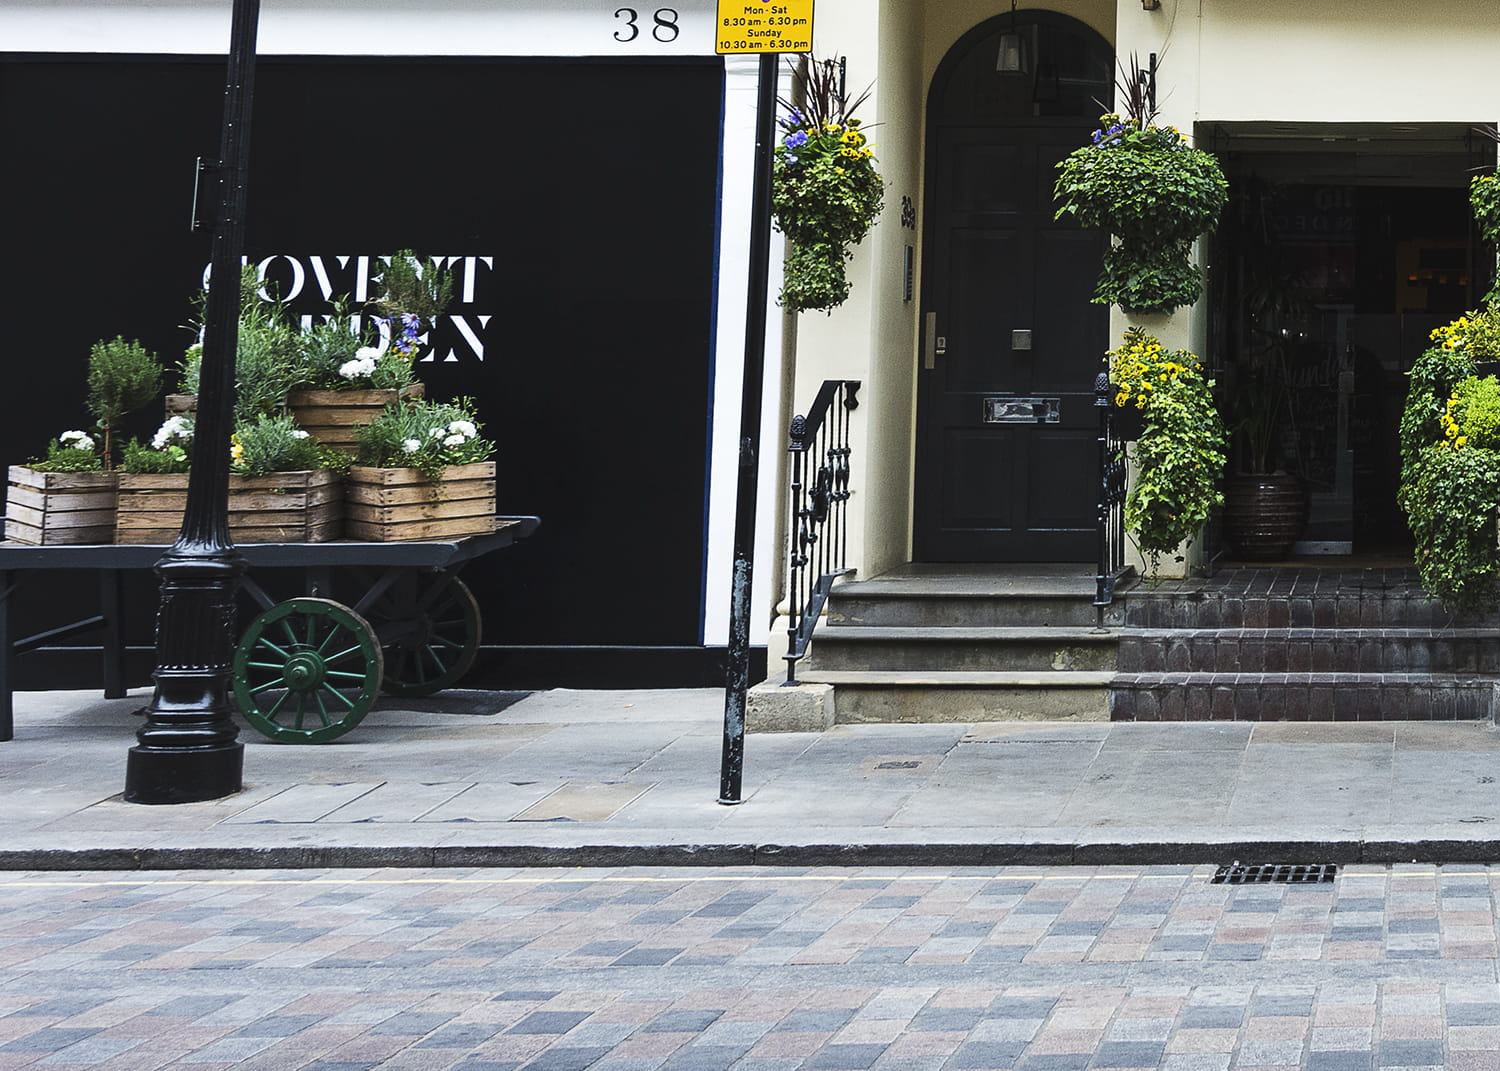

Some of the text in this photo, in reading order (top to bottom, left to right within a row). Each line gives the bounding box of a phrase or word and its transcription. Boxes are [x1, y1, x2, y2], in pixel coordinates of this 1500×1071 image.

[744, 7, 764, 15] Mon
[771, 5, 788, 15] Sat
[612, 7, 680, 43] 38
[723, 18, 746, 27] 8.30
[768, 17, 791, 26] 6.30
[792, 18, 807, 27] pm
[747, 29, 782, 39] Sunday
[720, 40, 747, 49] 10.30
[748, 41, 763, 49] am
[769, 40, 792, 49] 6.30
[793, 40, 808, 49] pm
